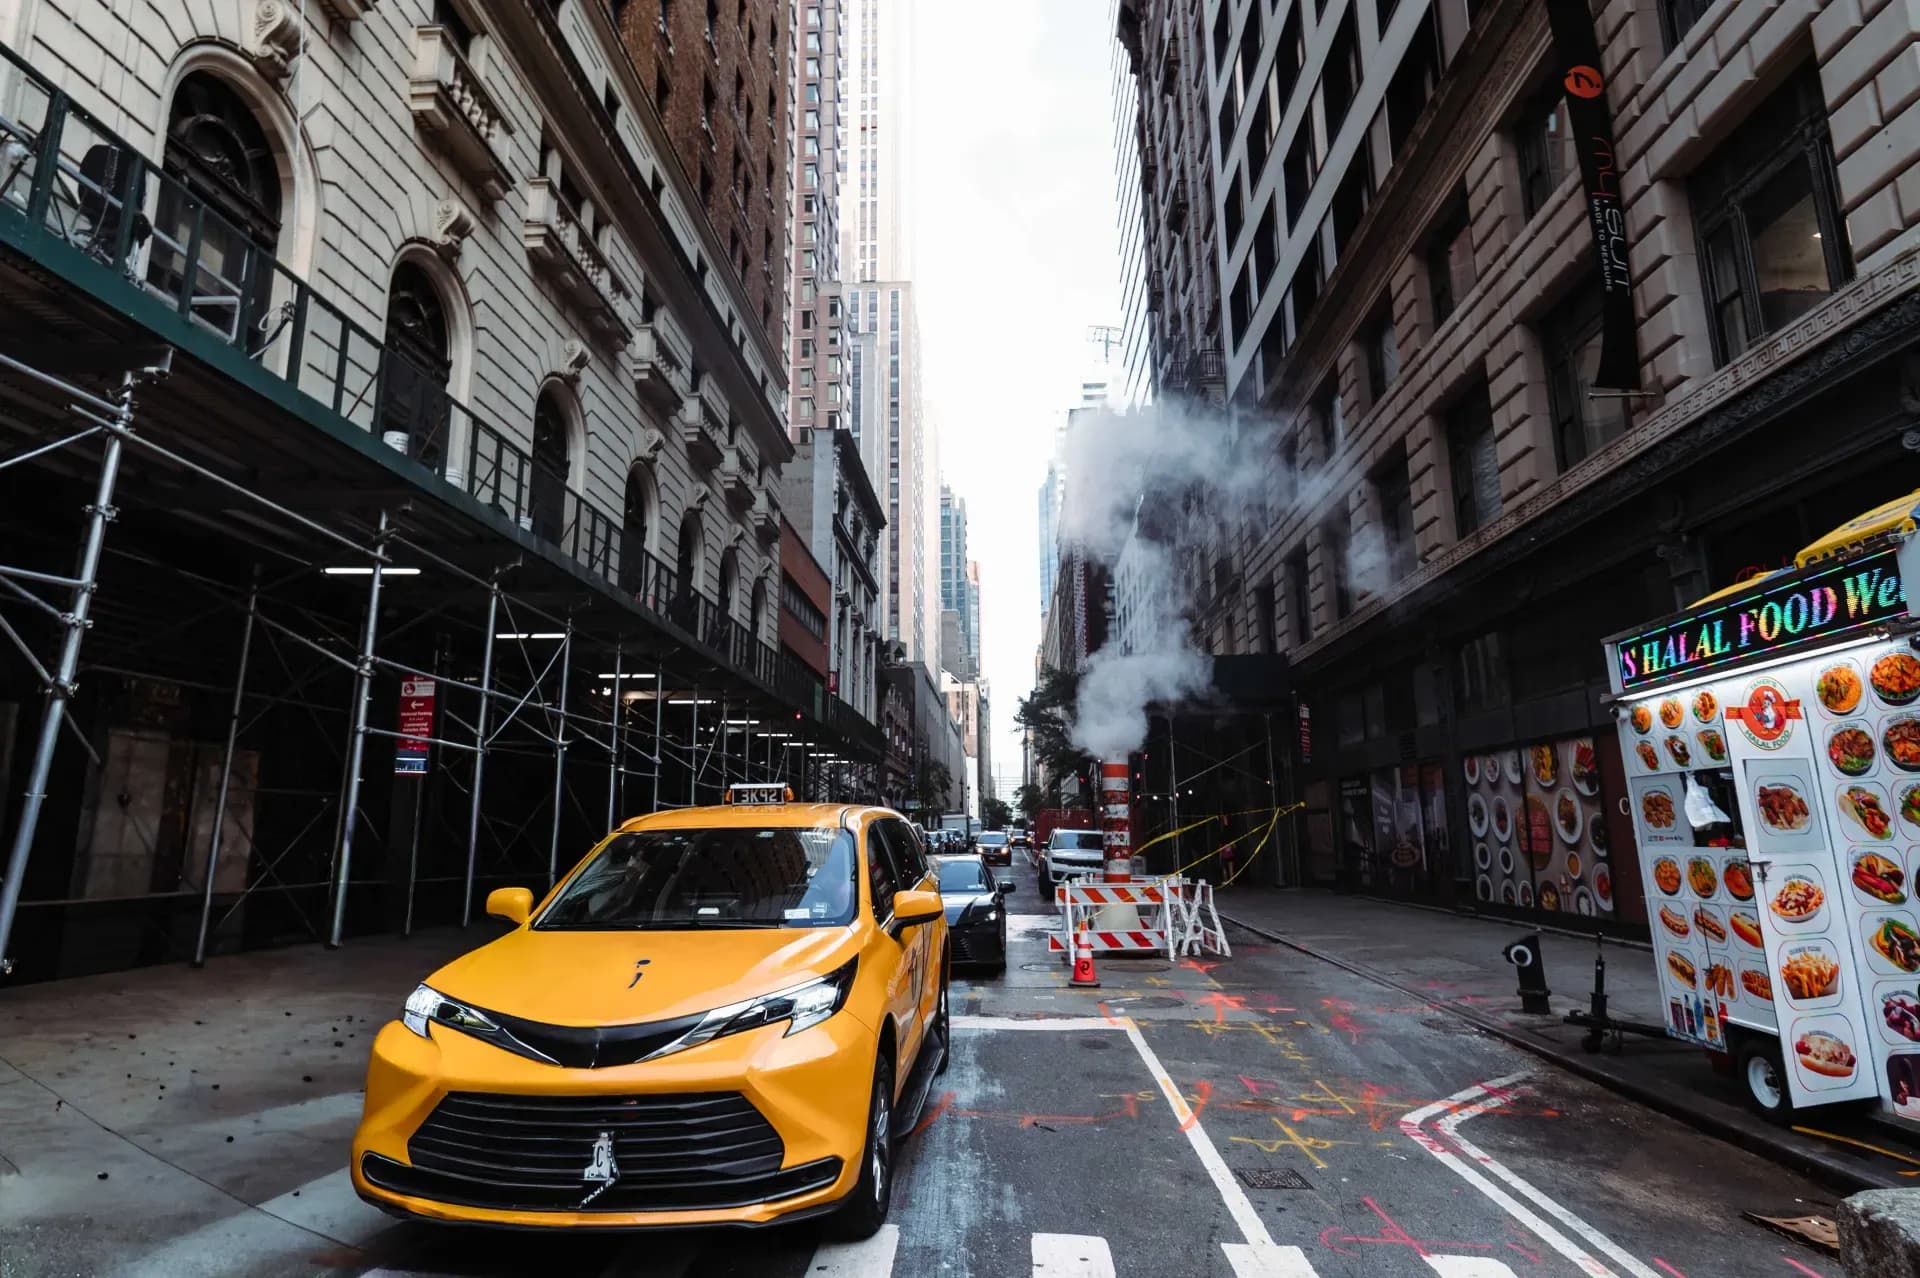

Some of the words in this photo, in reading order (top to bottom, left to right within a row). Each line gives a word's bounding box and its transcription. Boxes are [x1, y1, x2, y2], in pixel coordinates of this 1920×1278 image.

[1593, 199, 1603, 225] MADE
[1597, 229, 1606, 241] TO
[1600, 244, 1614, 292] MEASURE
[1642, 620, 1731, 676] HALAL
[1738, 586, 1838, 648] FOOD
[1744, 729, 1772, 749] HALAL
[1772, 729, 1790, 748] FOOD
[741, 789, 778, 803] 3K92
